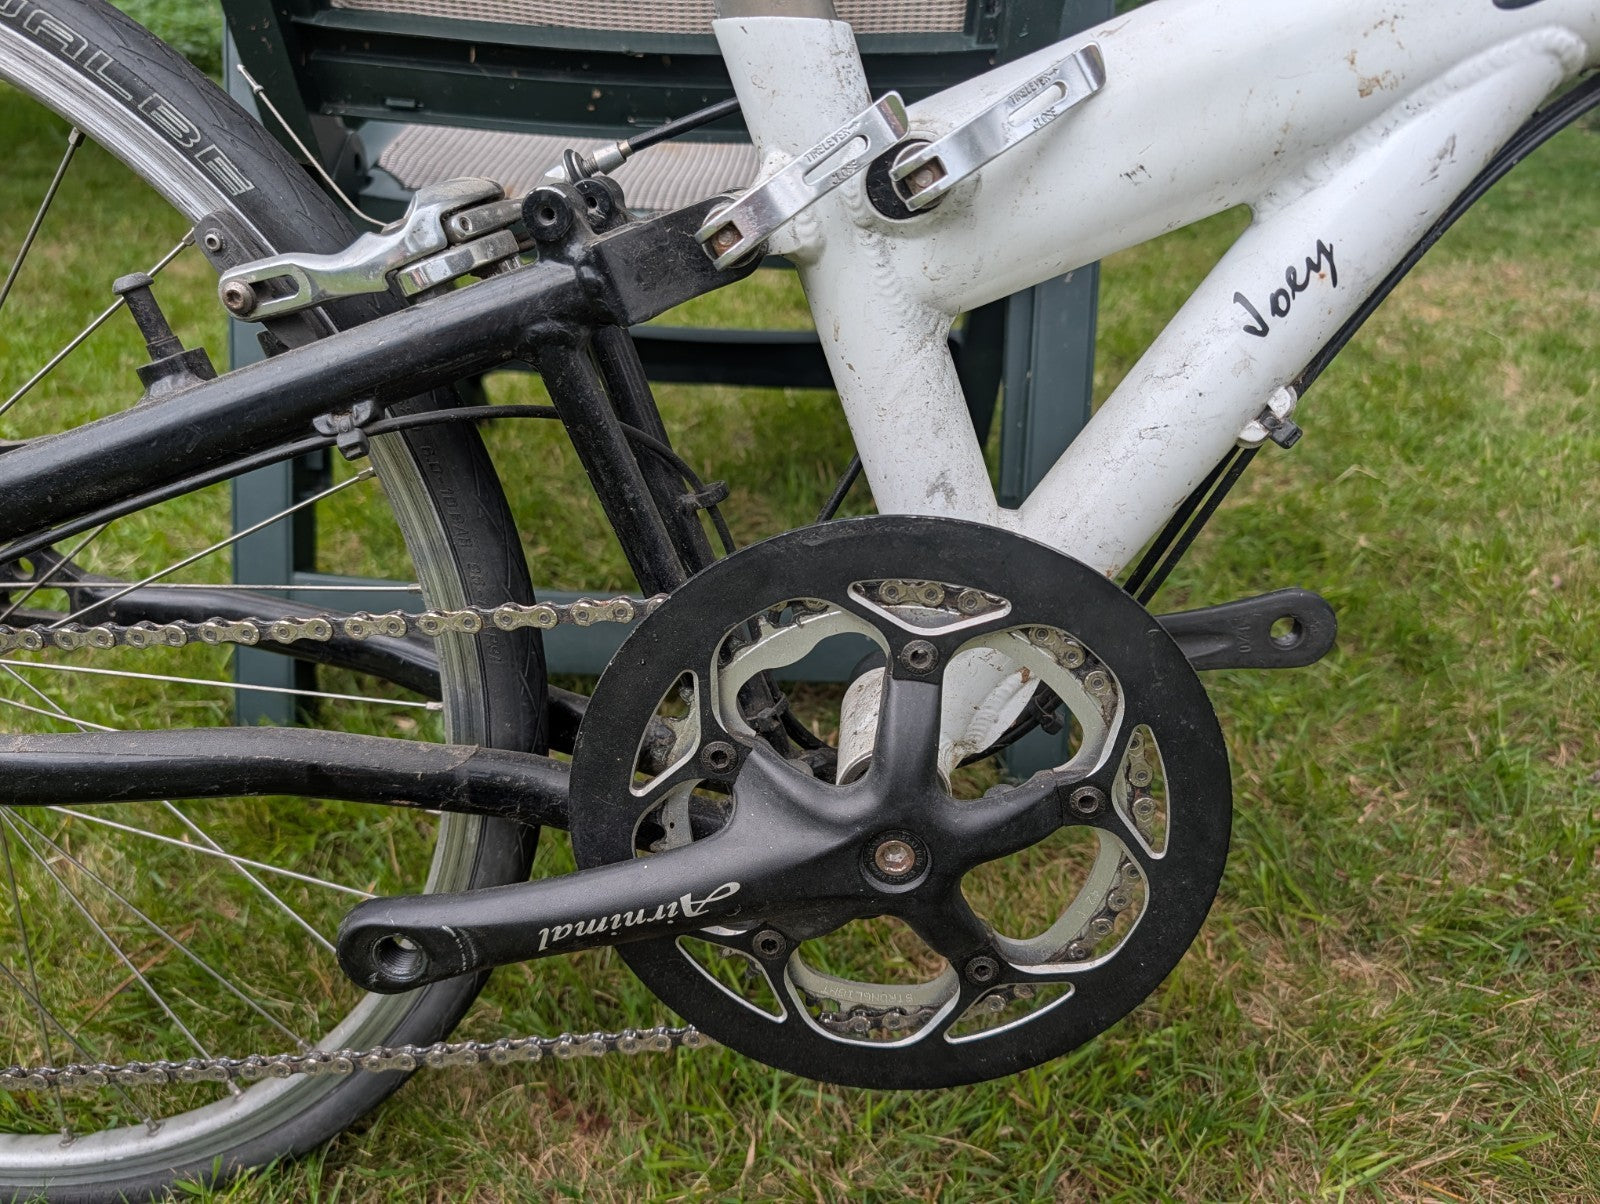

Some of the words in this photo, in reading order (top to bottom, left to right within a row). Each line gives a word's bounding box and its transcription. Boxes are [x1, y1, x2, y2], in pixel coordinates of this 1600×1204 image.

[803, 126, 851, 163] TIRELEVER
[1232, 239, 1338, 338] Joey
[537, 881, 741, 951] Airnimal
